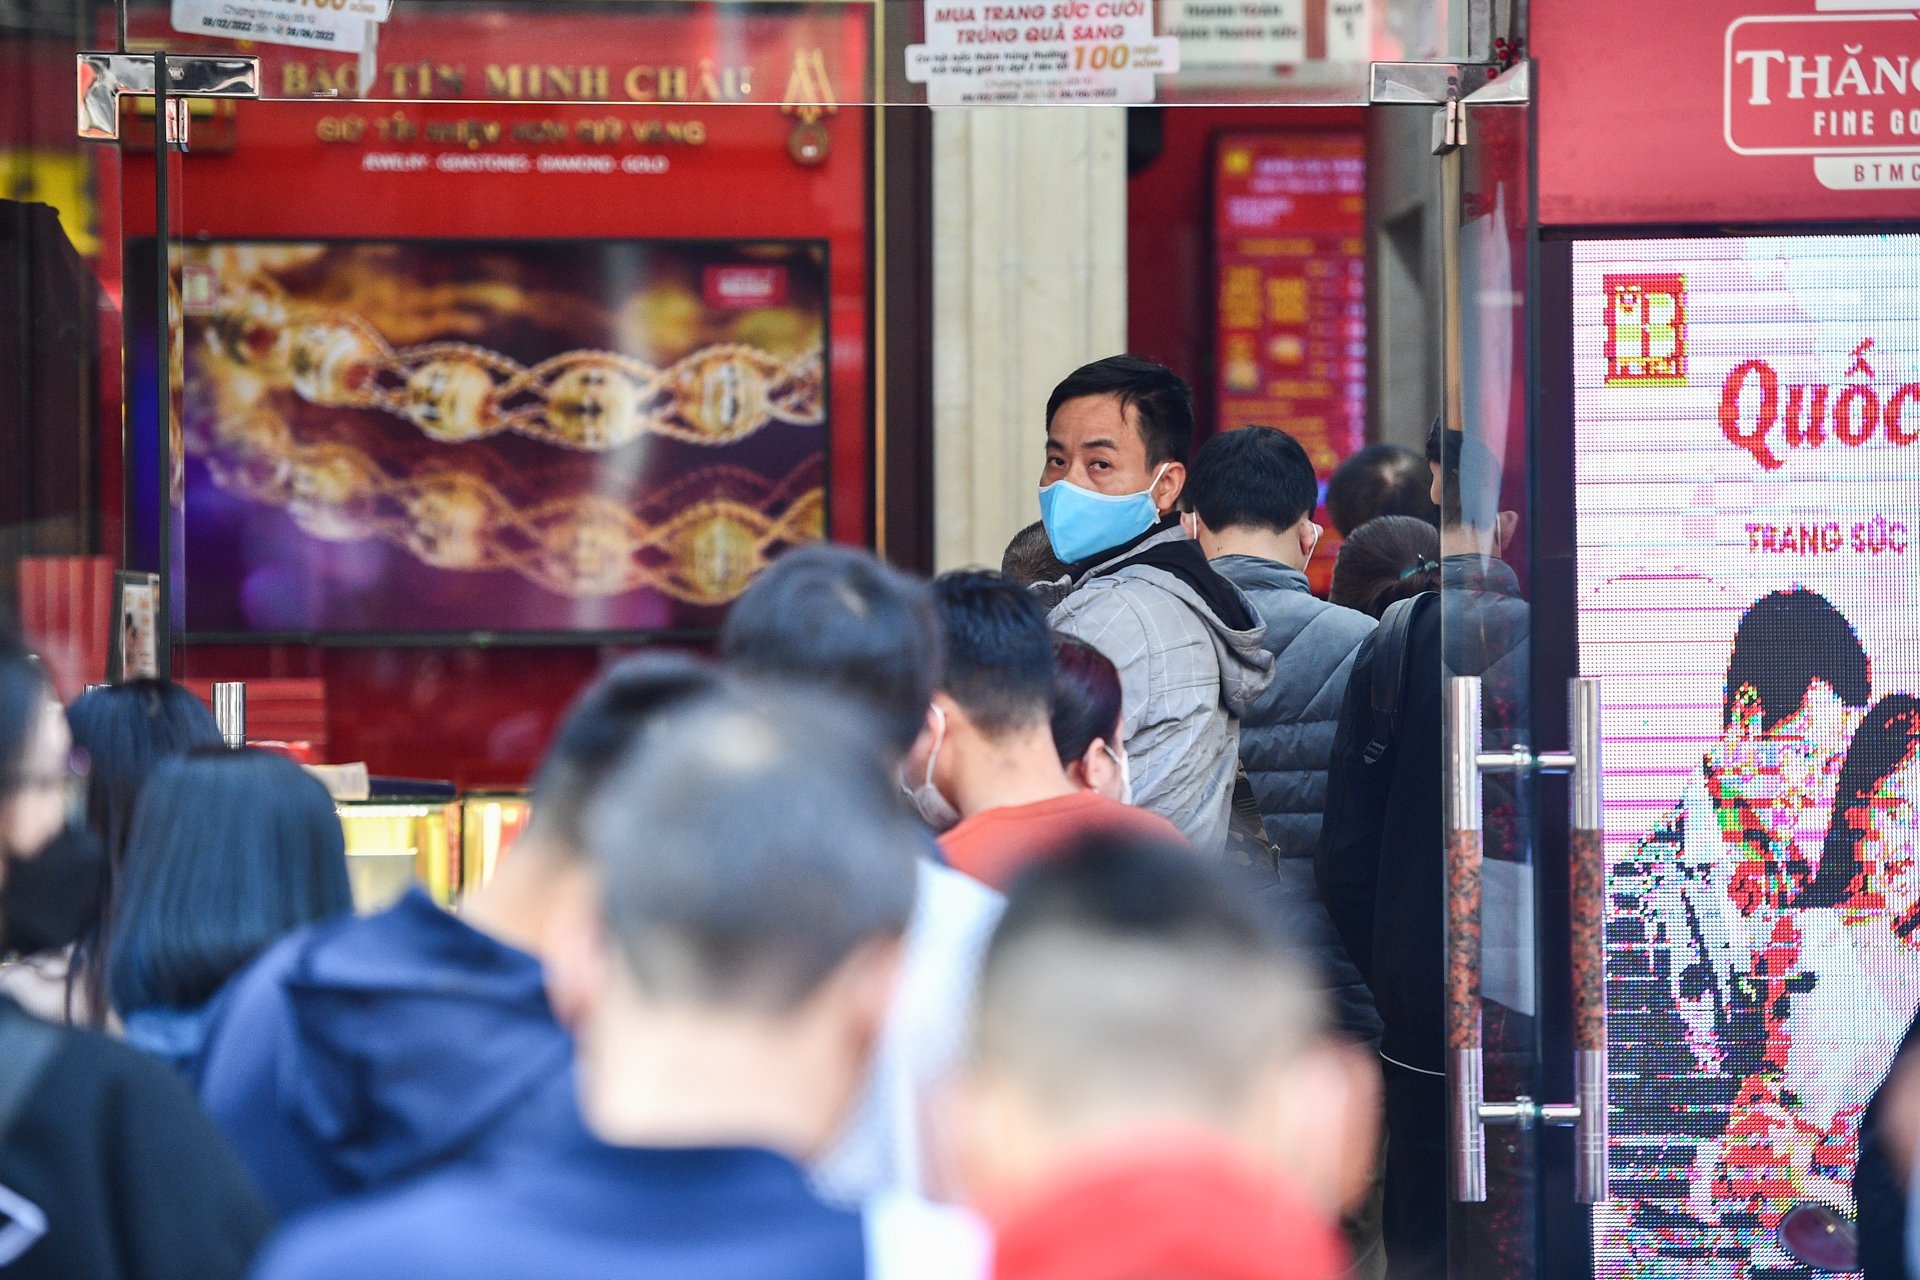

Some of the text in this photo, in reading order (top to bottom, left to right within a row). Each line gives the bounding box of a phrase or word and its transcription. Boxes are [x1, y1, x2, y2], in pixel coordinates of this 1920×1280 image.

[935, 7, 976, 22] MUA
[983, 4, 1046, 20] TRANG
[957, 24, 1019, 43] TRÚNG
[1072, 23, 1125, 41] SANG
[1074, 44, 1129, 71] 100
[485, 64, 609, 98] MINH
[1735, 44, 1920, 105] THĂN
[1814, 110, 1875, 136] FINE
[1854, 163, 1920, 182] BTMC
[1718, 336, 1920, 472] Quốc
[1745, 522, 1844, 556] TRANG
